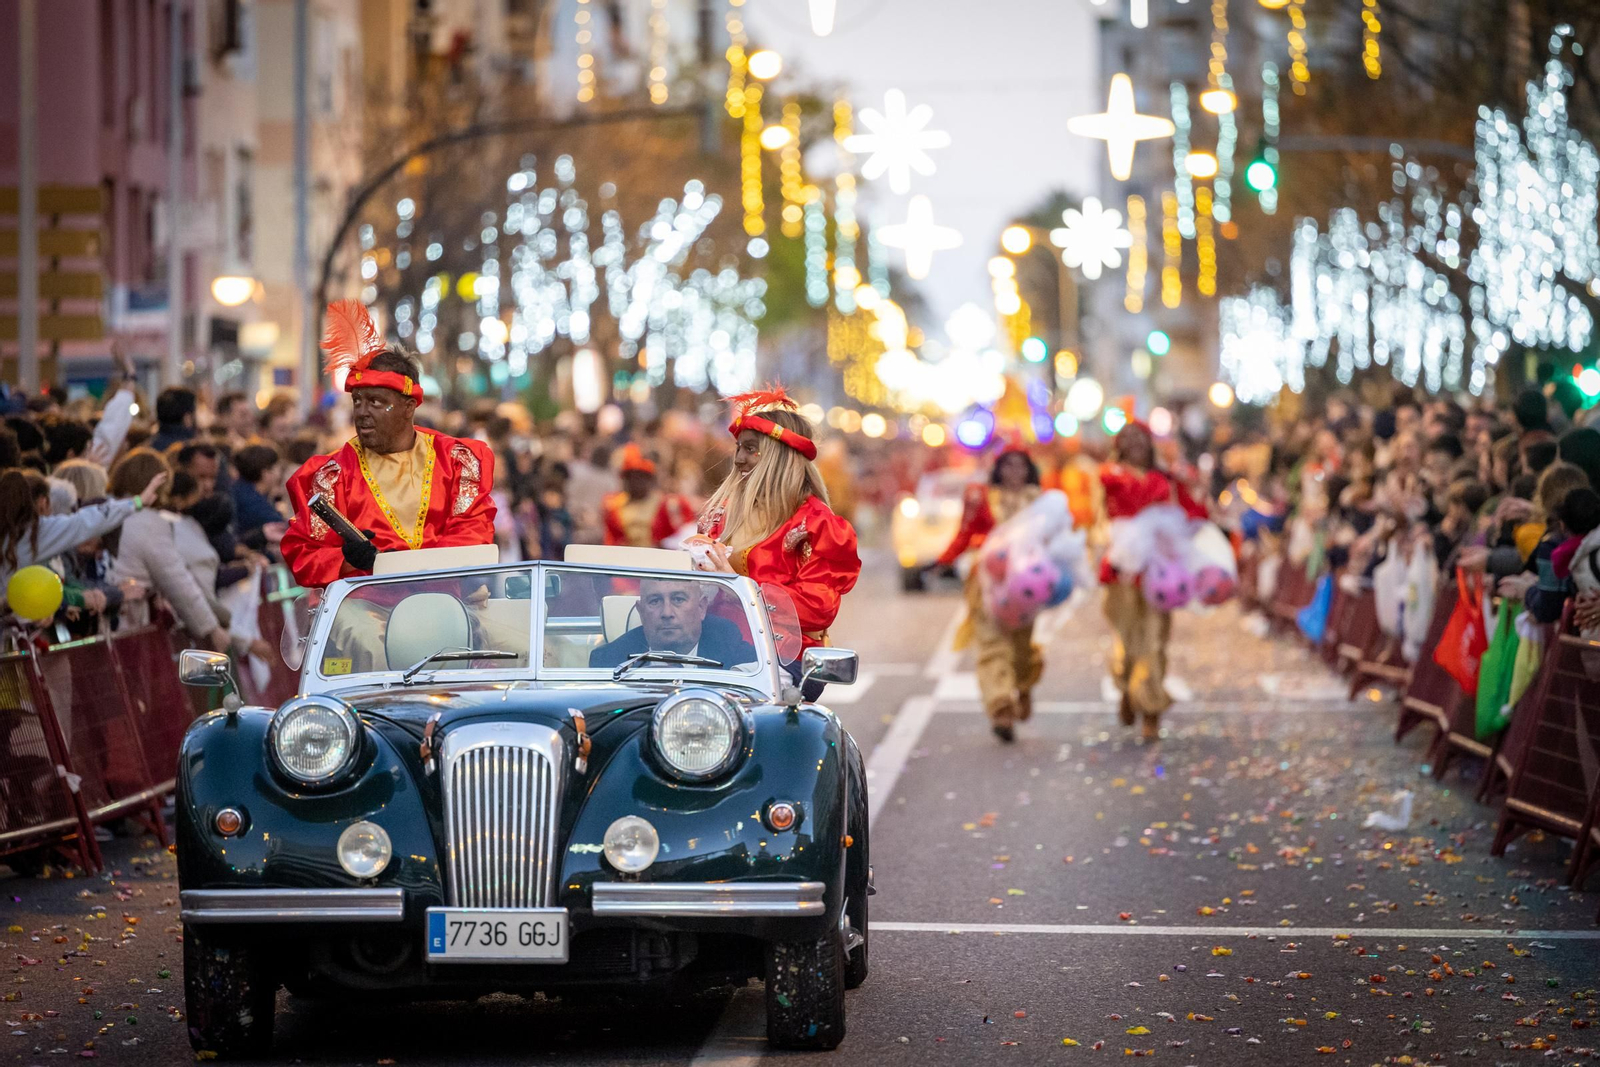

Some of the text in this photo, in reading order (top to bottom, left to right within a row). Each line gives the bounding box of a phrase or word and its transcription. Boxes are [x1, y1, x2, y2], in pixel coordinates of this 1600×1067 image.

[433, 937, 441, 947] E
[450, 921, 560, 946] 7736 GGJ
